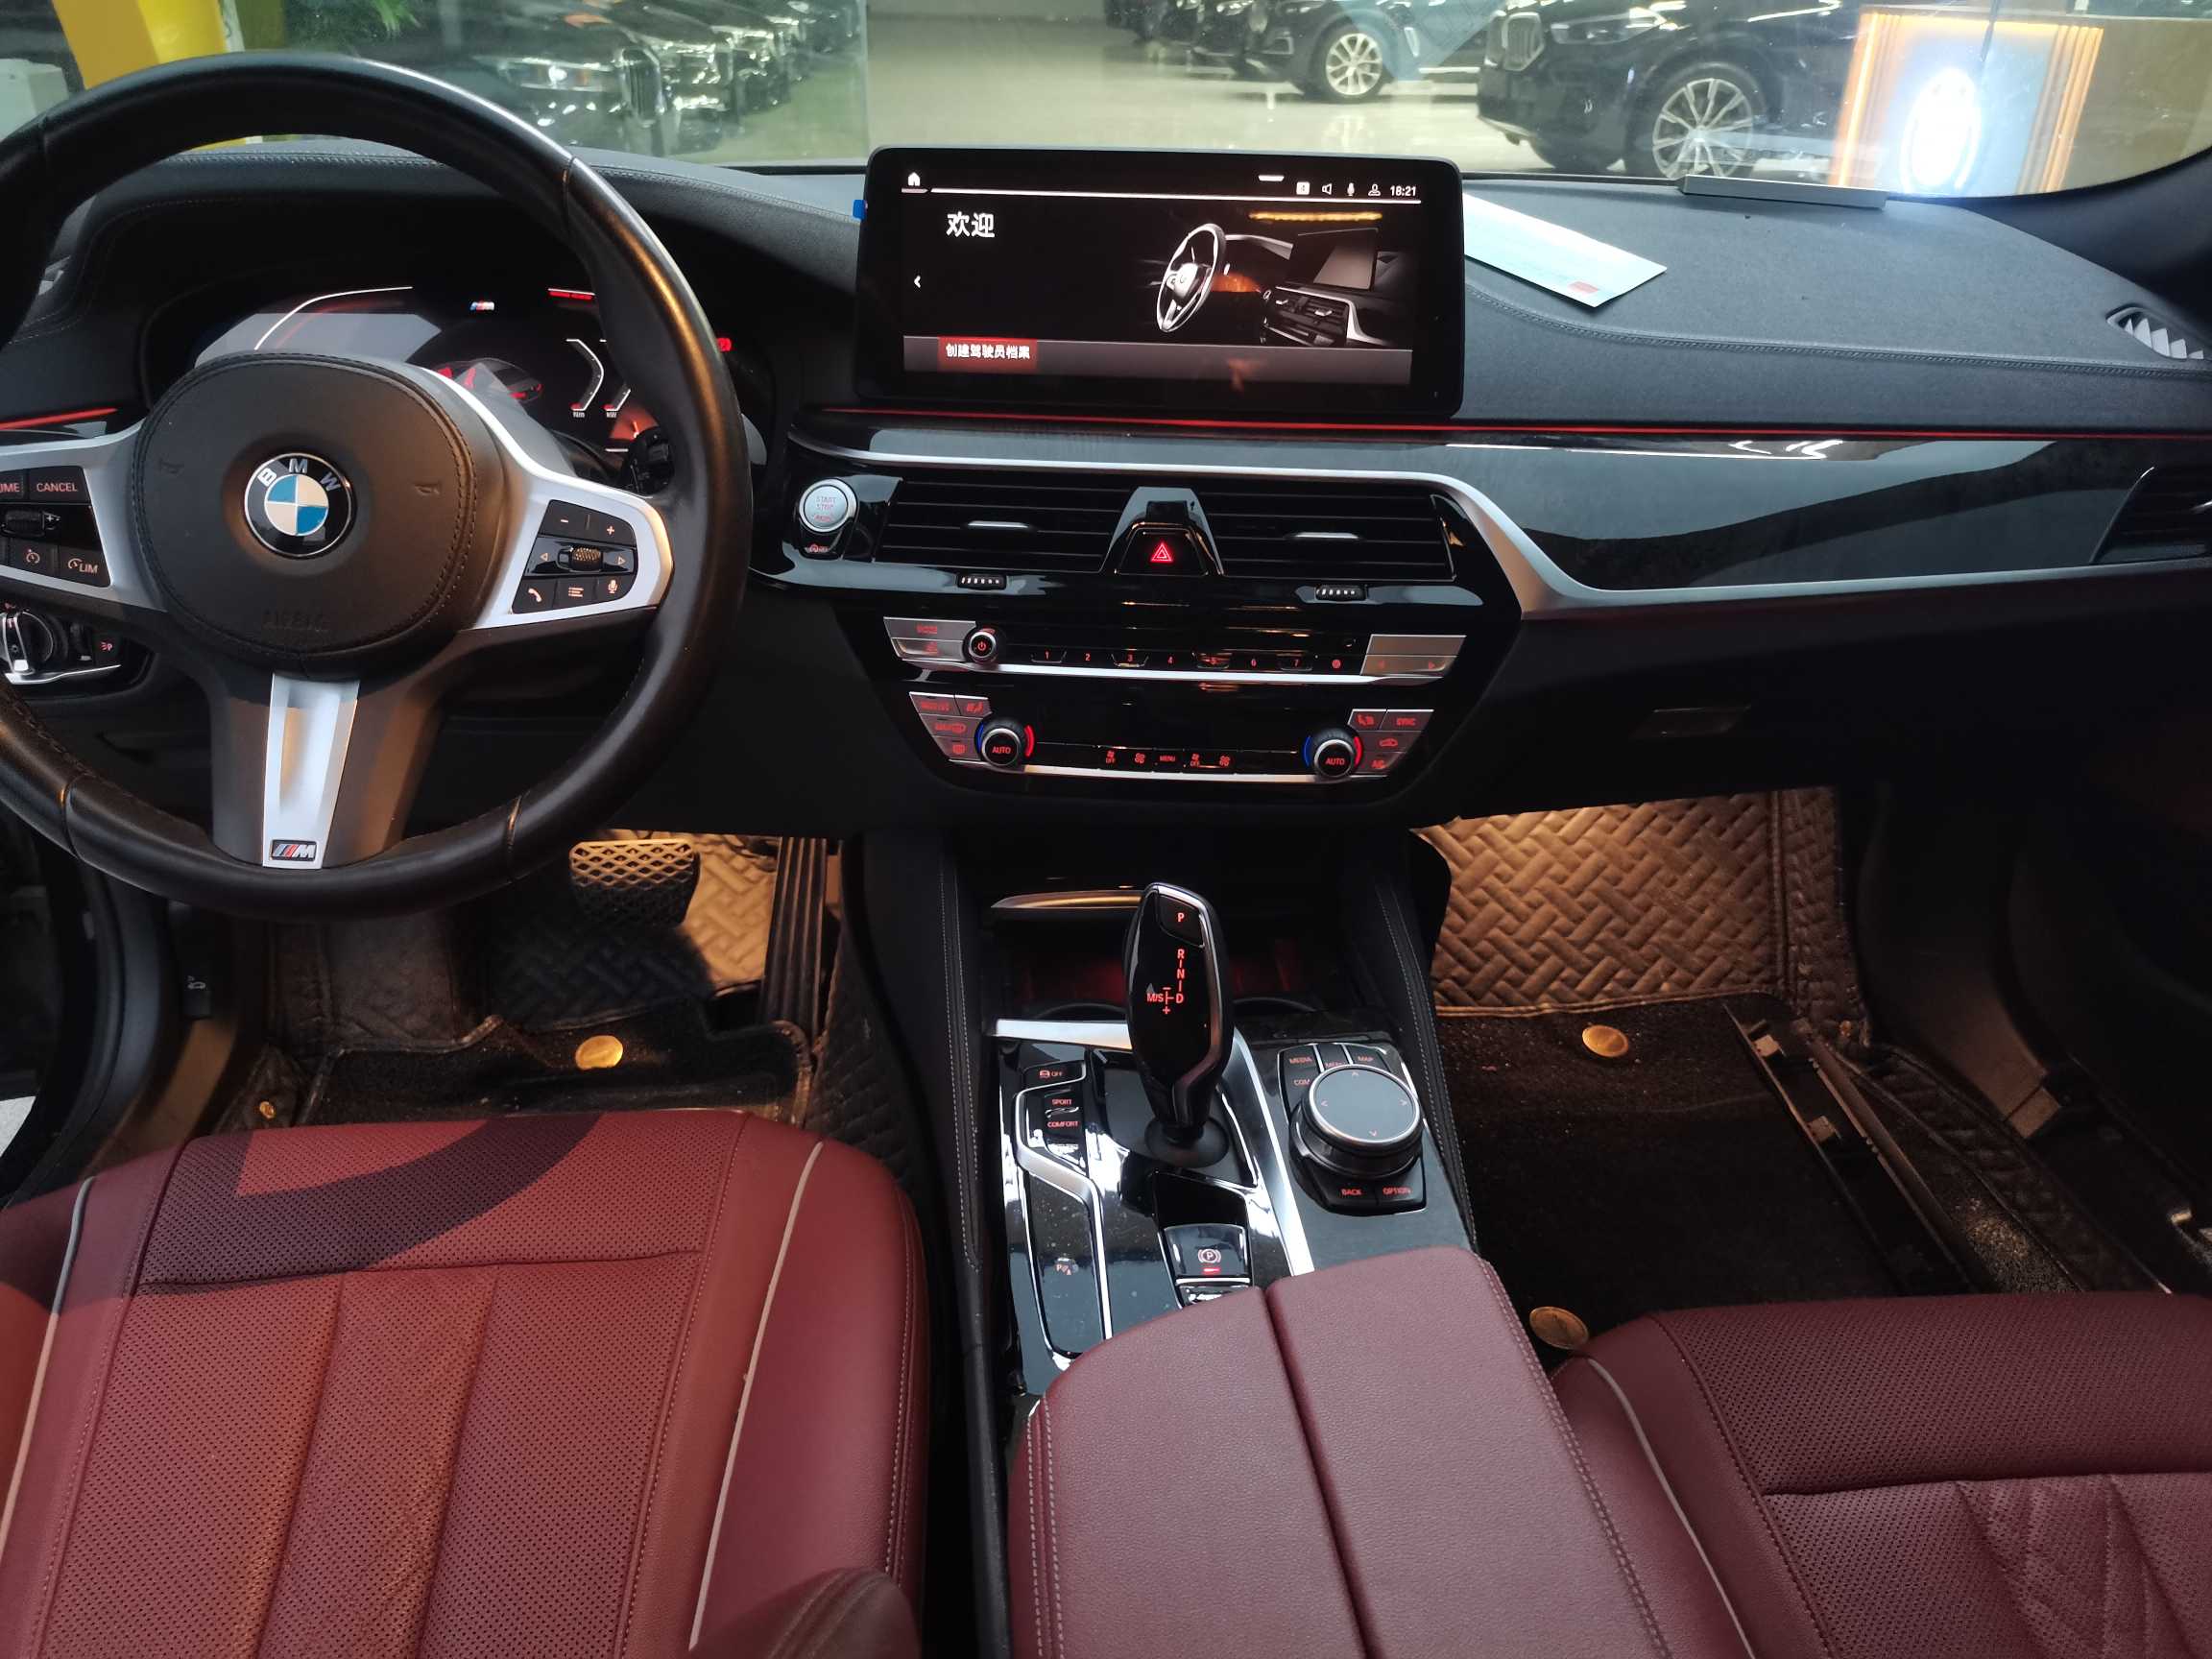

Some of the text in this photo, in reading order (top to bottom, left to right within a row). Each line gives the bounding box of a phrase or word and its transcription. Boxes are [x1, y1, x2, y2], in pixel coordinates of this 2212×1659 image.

[1389, 185, 1417, 197] 18:21
[946, 210, 996, 238] 欢迎
[945, 343, 1031, 360] 创建驾驶员档案
[257, 458, 342, 492] BMW
[36, 482, 79, 493] CANCEL
[79, 563, 99, 574] LIM
[992, 745, 1011, 755] AUTO
[1325, 757, 1345, 766] AUTO
[1177, 912, 1185, 923] P
[1177, 949, 1185, 959] R
[1176, 968, 1186, 979] N
[1175, 993, 1185, 1003] D
[1341, 1188, 1362, 1196] BACK
